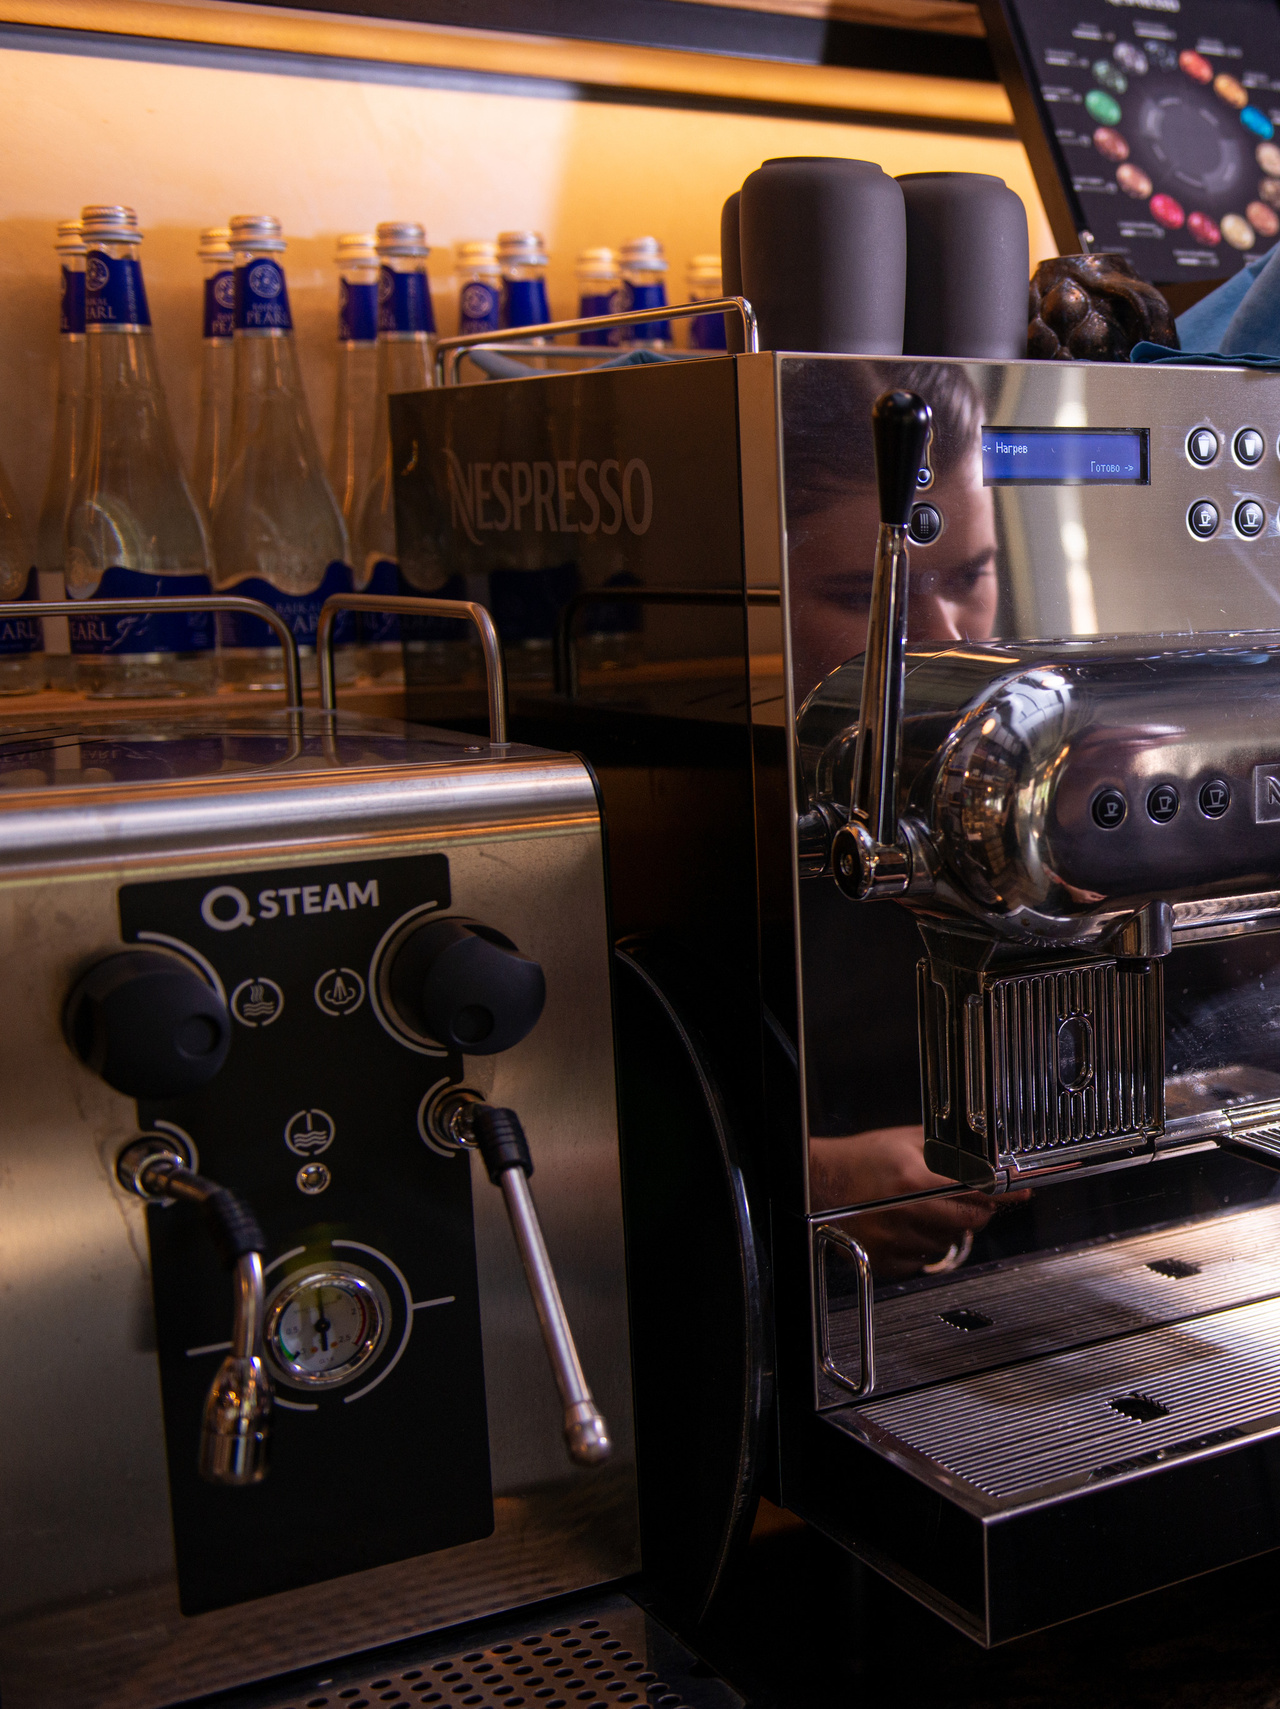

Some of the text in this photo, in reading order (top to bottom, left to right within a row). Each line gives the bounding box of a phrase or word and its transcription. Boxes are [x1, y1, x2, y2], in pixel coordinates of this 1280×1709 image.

[995, 441, 1028, 455] Нагрев
[1091, 460, 1120, 473] Готово
[443, 448, 653, 546] NESPRESSO
[2, 619, 37, 640] ARL
[71, 621, 112, 641] EARL
[201, 879, 380, 931] Q STEAM
